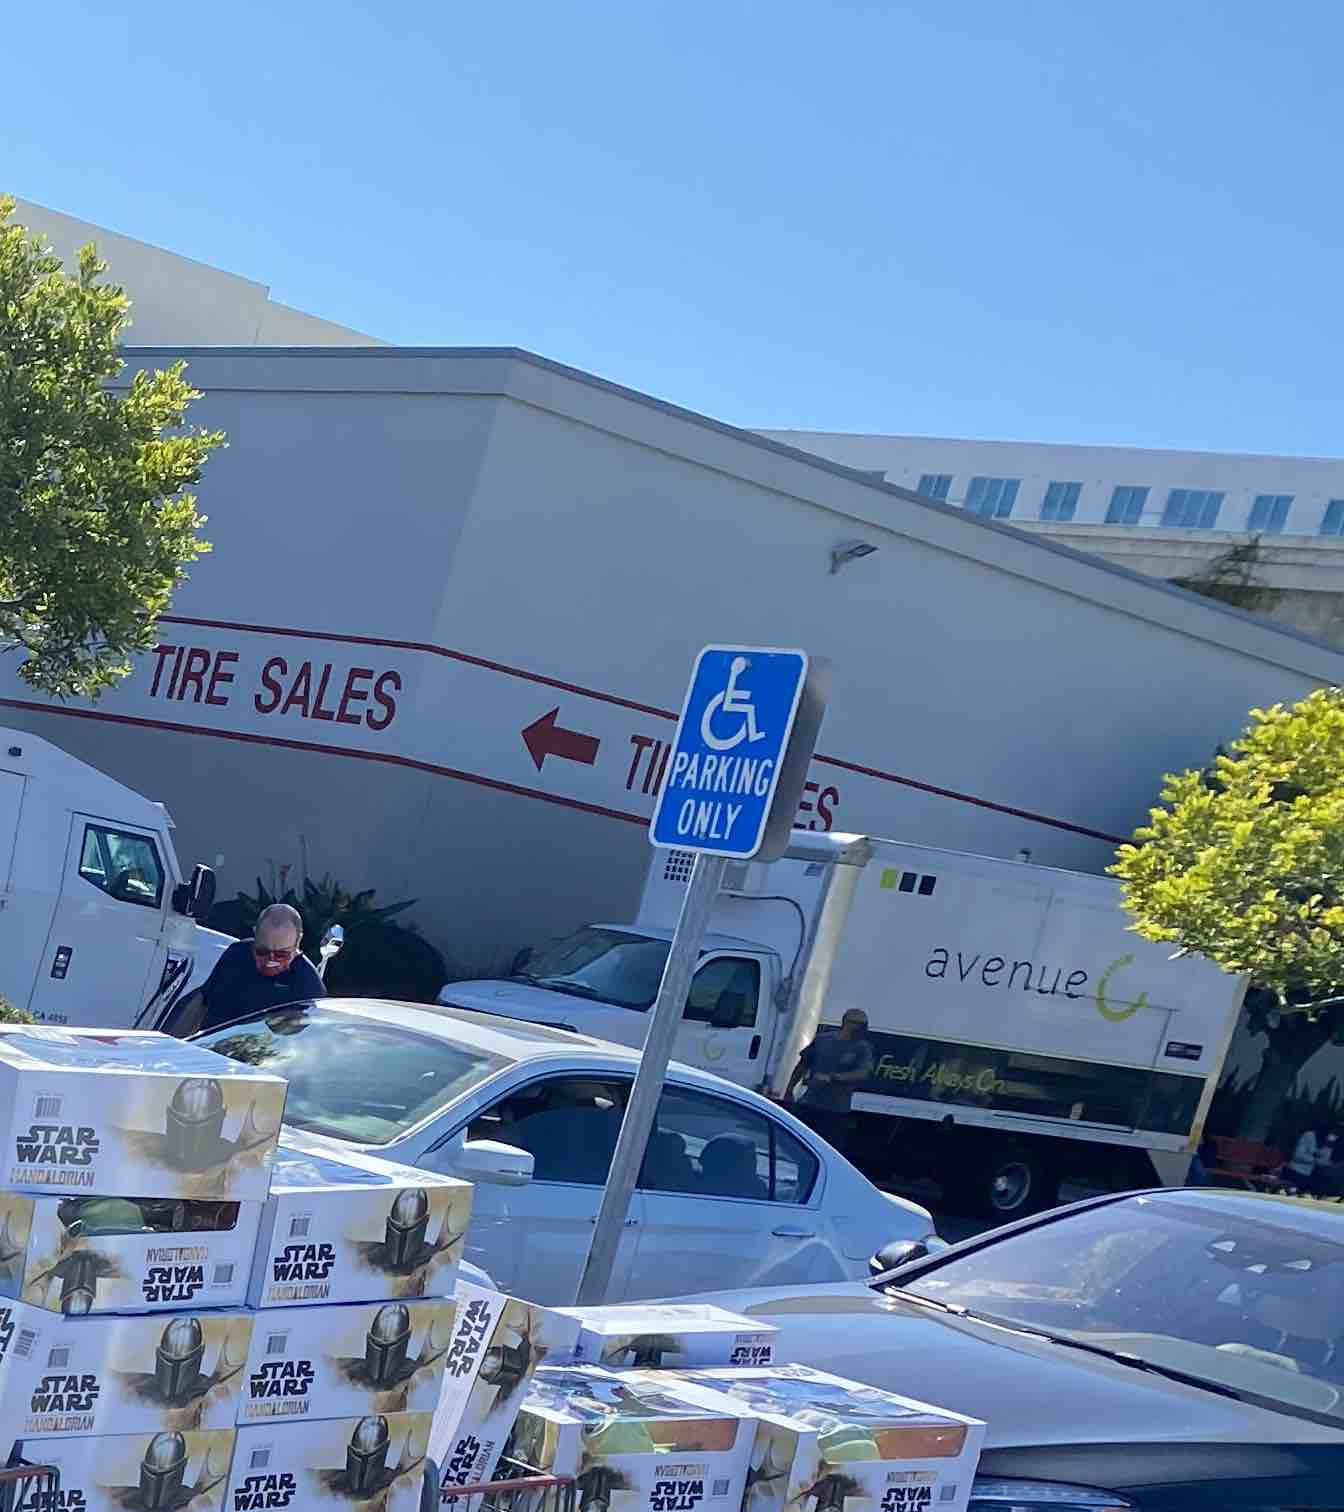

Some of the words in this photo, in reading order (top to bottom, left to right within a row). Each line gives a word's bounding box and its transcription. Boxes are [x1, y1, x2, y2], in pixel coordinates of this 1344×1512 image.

[151, 644, 239, 705] TIRE
[255, 656, 402, 730] SALES
[626, 735, 671, 796] TI
[669, 752, 773, 796] PARKING
[677, 799, 742, 839] ONLY
[925, 947, 1087, 999] avenue
[16, 1124, 100, 1147] STAR
[16, 1144, 100, 1166] WARS
[10, 1167, 95, 1187] MANDALORIAN
[274, 1244, 336, 1263] STAR
[143, 1267, 204, 1286] WARS
[274, 1262, 334, 1281] WARS
[142, 1284, 204, 1302] STAR
[446, 1299, 484, 1377] WARS
[455, 1301, 492, 1378] STAR
[250, 1360, 315, 1380] STAR
[34, 1375, 100, 1394] STAR
[250, 1378, 313, 1398] WARS
[30, 1393, 98, 1412] WARS
[234, 1473, 296, 1494] STAR
[651, 1480, 704, 1496] WARS
[234, 1490, 296, 1511] WARS
[650, 1495, 703, 1511] STAR
[882, 1487, 931, 1501] WARS
